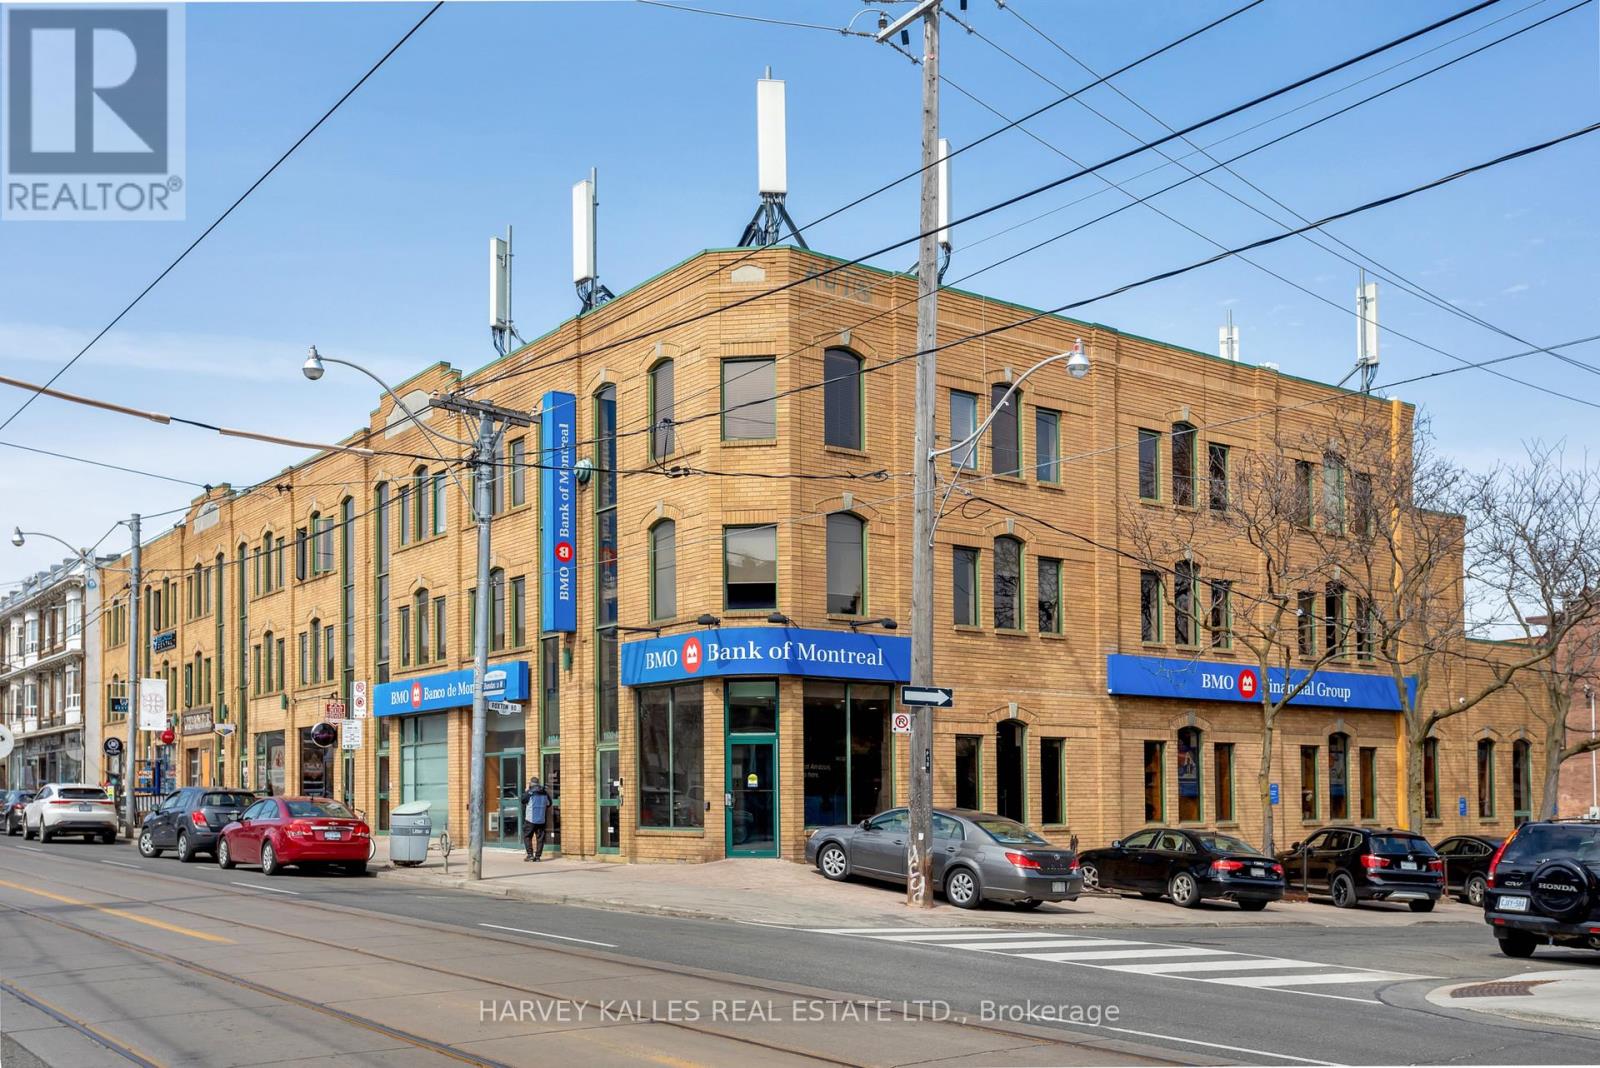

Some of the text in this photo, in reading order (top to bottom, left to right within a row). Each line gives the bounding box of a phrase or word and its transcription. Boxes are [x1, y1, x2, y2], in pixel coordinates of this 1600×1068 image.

[559, 423, 569, 600] BMO Bank of Montreal
[645, 641, 884, 670] BMO Bank of Montreal
[391, 690, 409, 705] BMO
[423, 687, 445, 701] Banco
[447, 683, 457, 696] de
[1202, 673, 1234, 690] BMO
[1316, 682, 1351, 702] Group
[1538, 882, 1578, 892] HONDA
